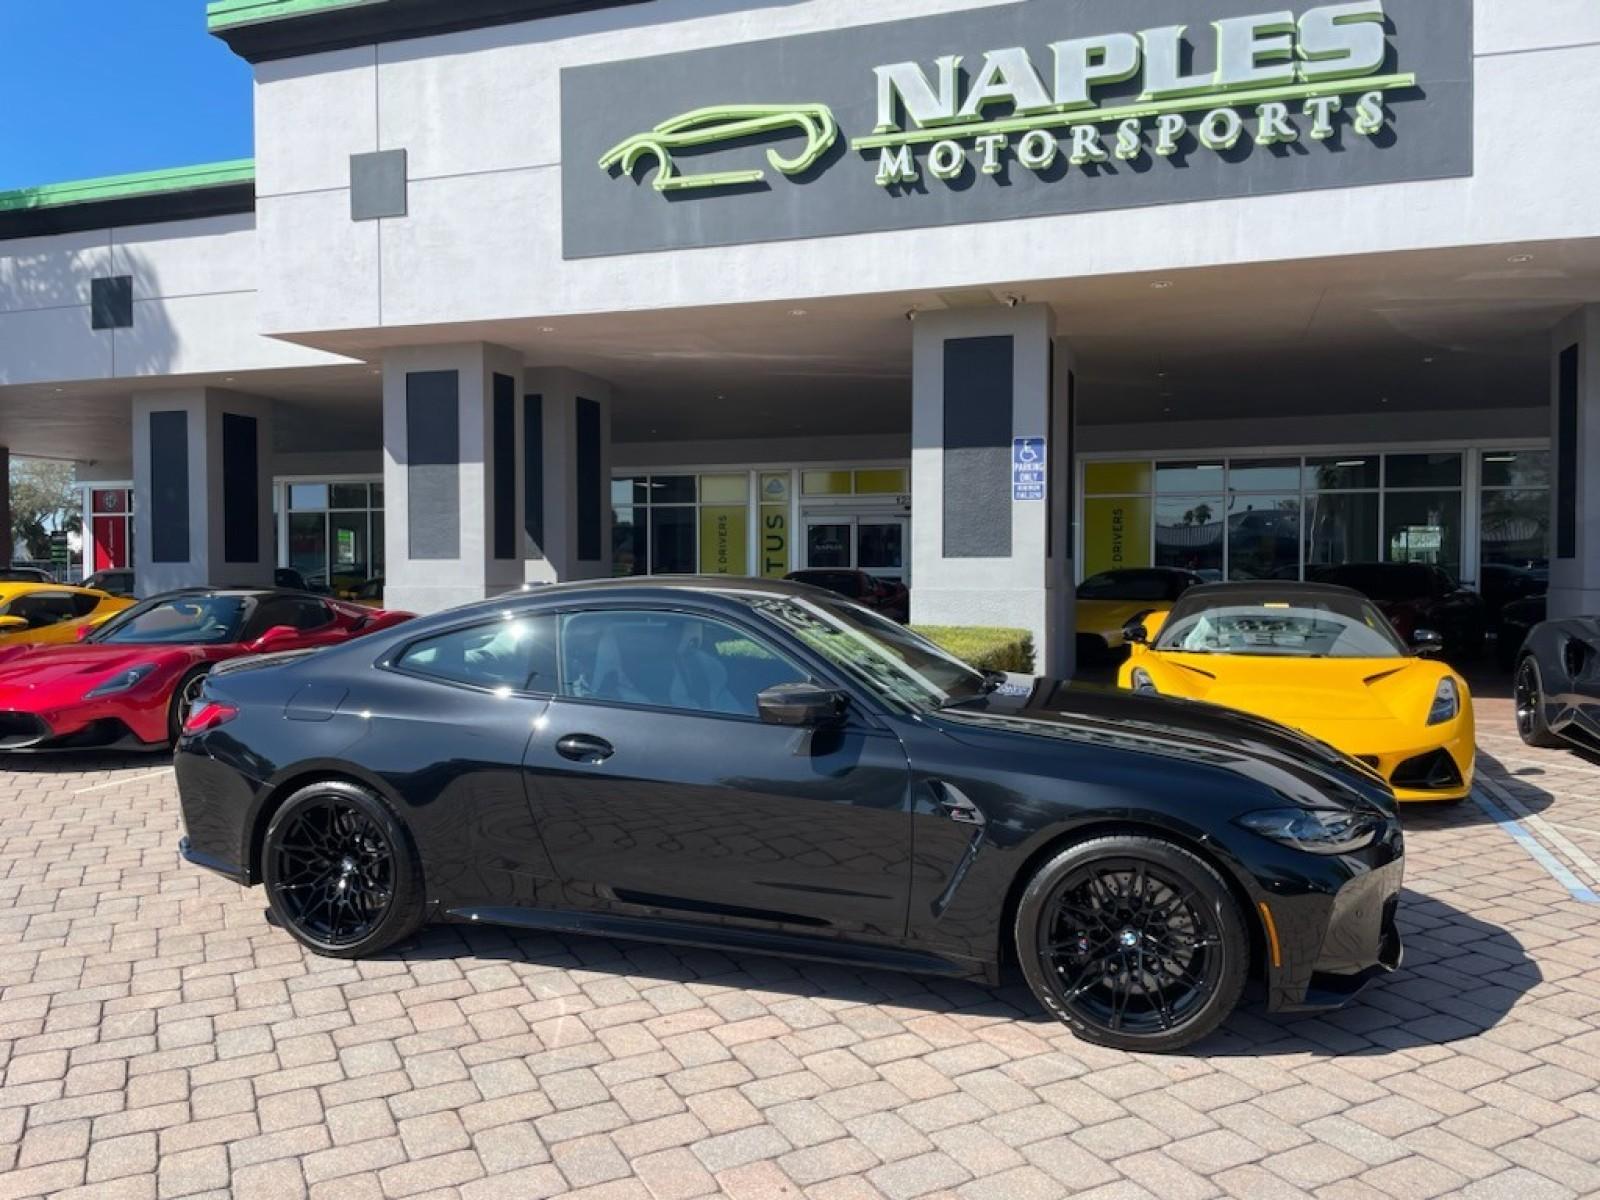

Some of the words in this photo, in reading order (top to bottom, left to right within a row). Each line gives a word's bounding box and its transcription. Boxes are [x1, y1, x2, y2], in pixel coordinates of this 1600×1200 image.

[872, 0, 1386, 134] NAPLES
[876, 91, 1385, 185] MOTORSPORTS
[718, 515, 728, 564] DRIVERS
[1112, 508, 1123, 562] DRIVERS
